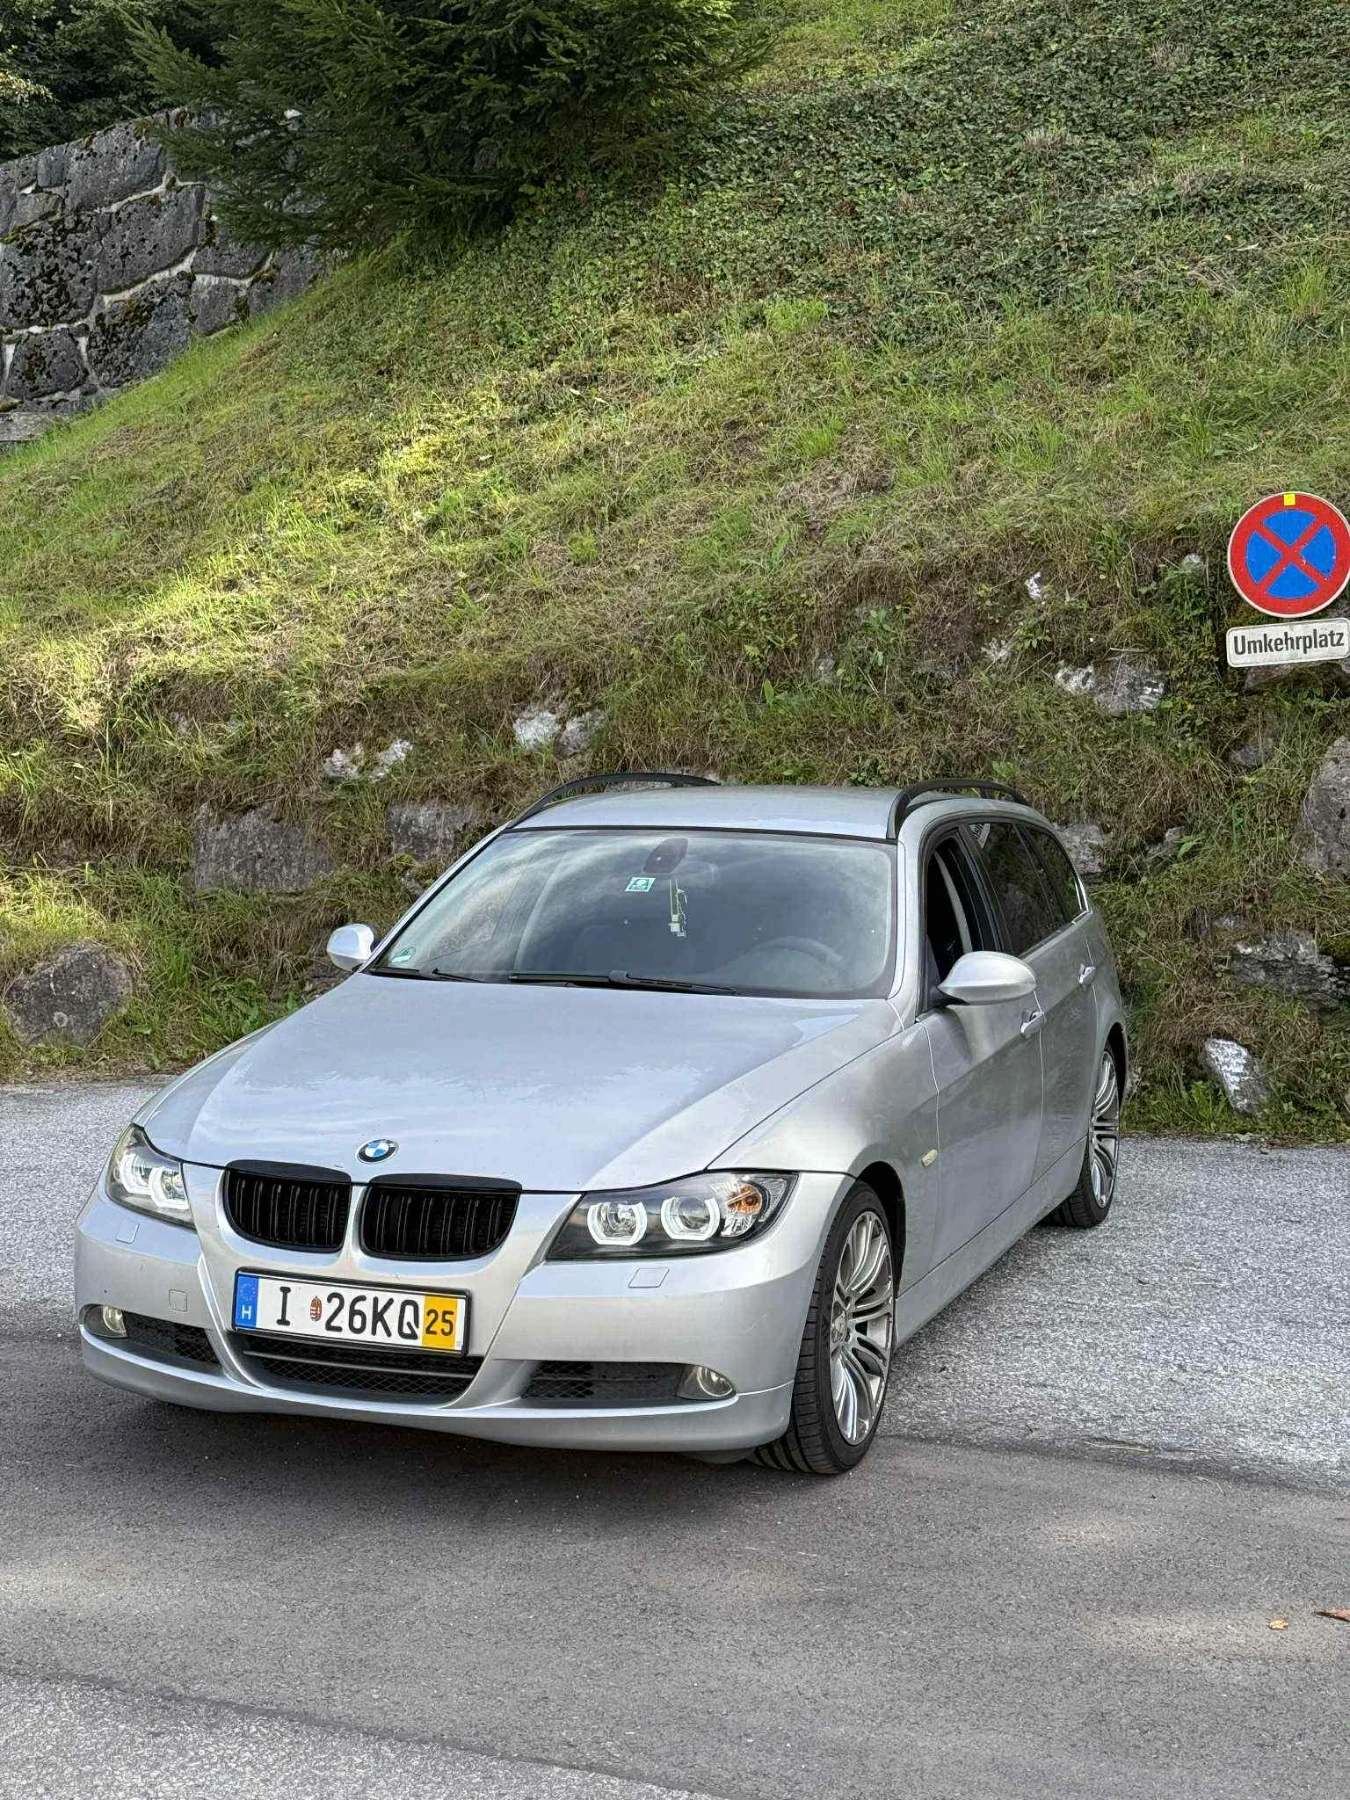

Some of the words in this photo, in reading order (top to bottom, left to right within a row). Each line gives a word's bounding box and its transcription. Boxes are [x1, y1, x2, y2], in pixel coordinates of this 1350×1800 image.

[1233, 628, 1345, 656] Umkehrplatz
[241, 1305, 252, 1320] H
[276, 1286, 291, 1327] I
[325, 1292, 420, 1341] 26KQ
[425, 1308, 455, 1337] 25
